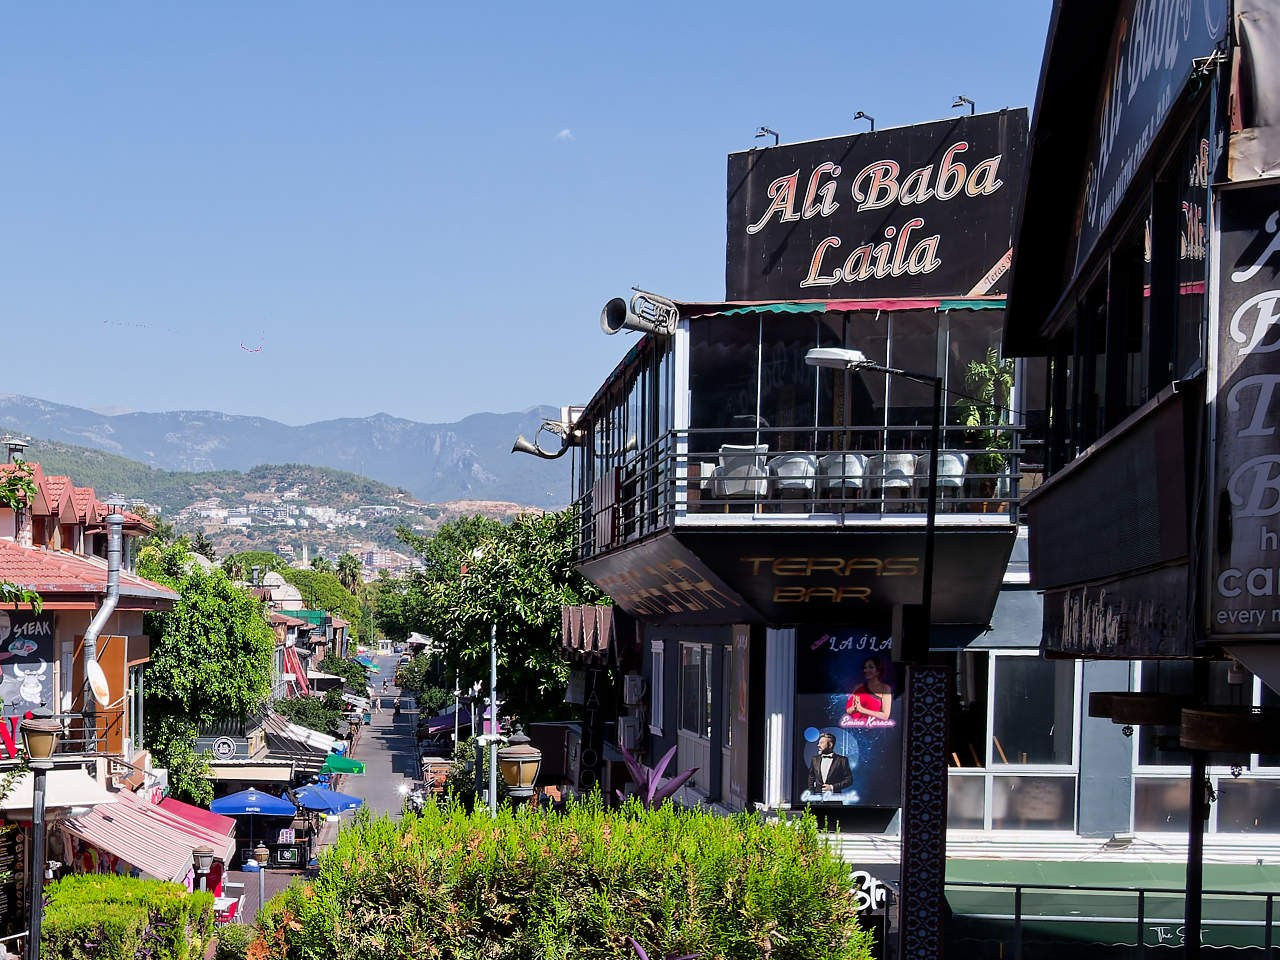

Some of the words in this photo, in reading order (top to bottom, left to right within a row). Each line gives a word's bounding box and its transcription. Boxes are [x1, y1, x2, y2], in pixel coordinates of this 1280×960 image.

[746, 161, 842, 235] Ali
[852, 141, 1004, 213] Baba
[800, 218, 942, 289] Laila
[740, 556, 920, 577] TERAS
[773, 586, 872, 603] BAR
[1217, 610, 1266, 626] every
[13, 620, 52, 638] STEAK
[1149, 926, 1173, 943] The
